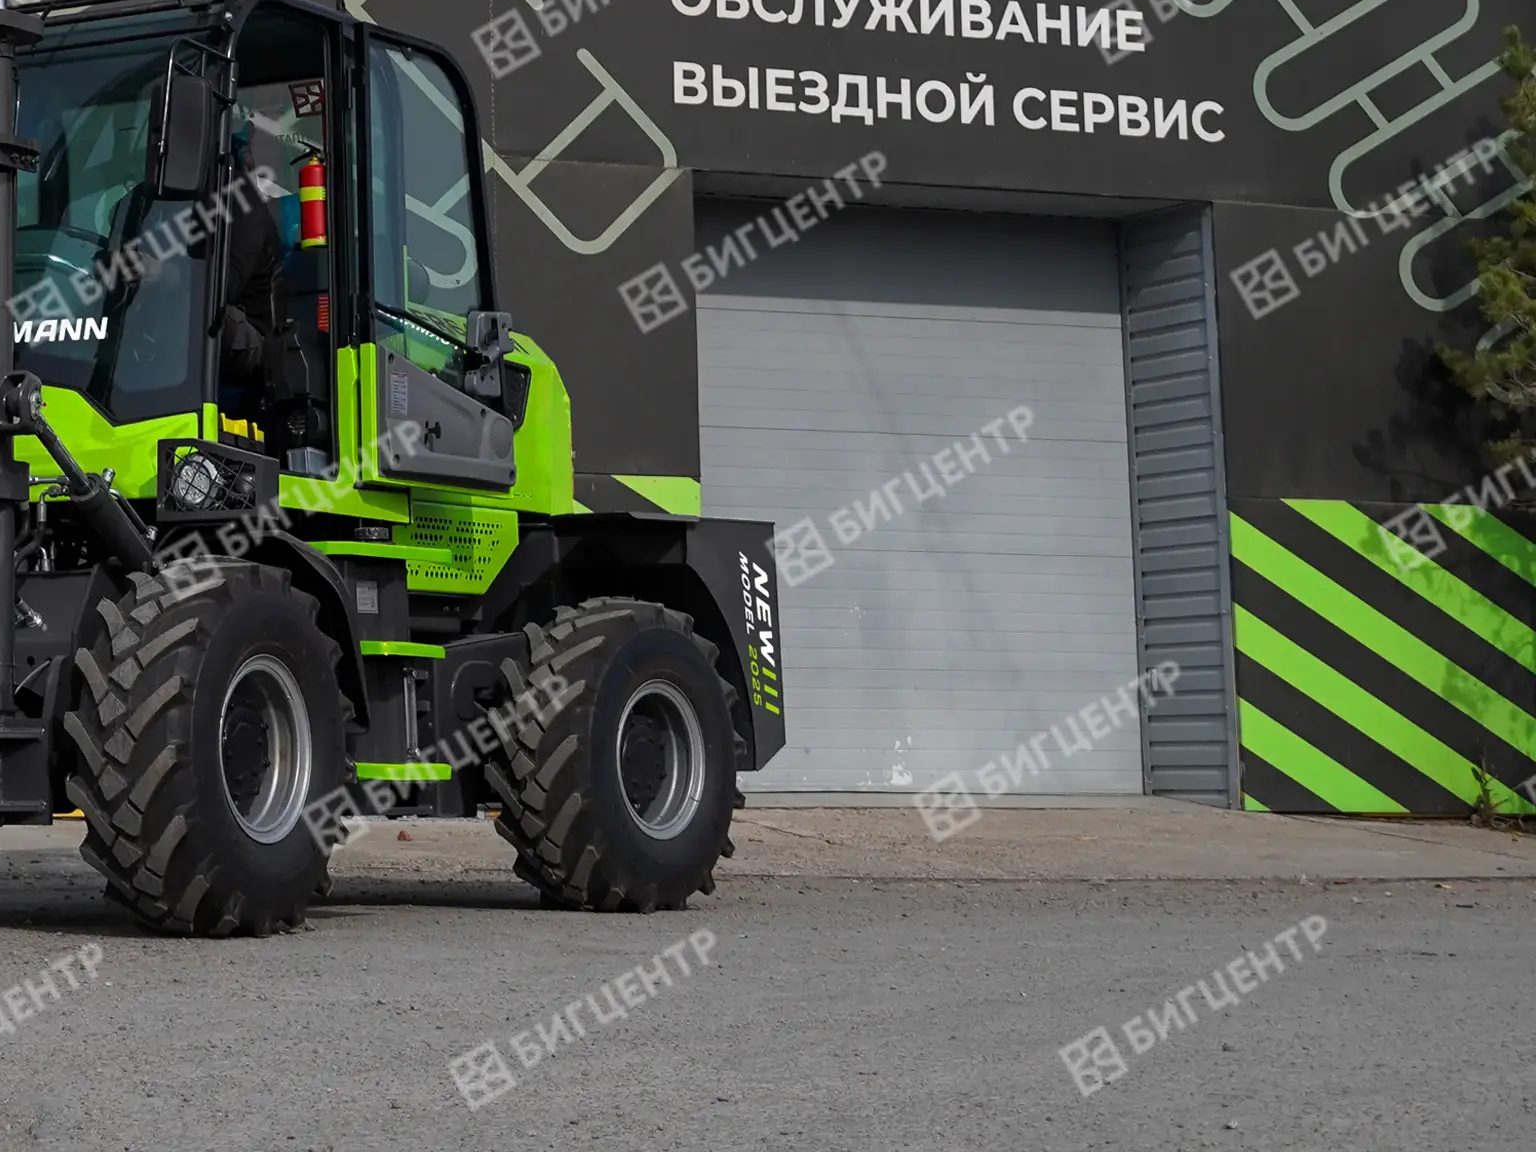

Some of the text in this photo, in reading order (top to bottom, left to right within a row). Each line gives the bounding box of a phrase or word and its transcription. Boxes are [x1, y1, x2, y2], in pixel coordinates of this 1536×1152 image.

[672, 60, 1226, 143] ВЫЕЗДНОЙ СЕРВИС
[13, 316, 109, 344] MANN
[738, 551, 763, 707] MODEL 2025
[752, 562, 776, 667] NEW
